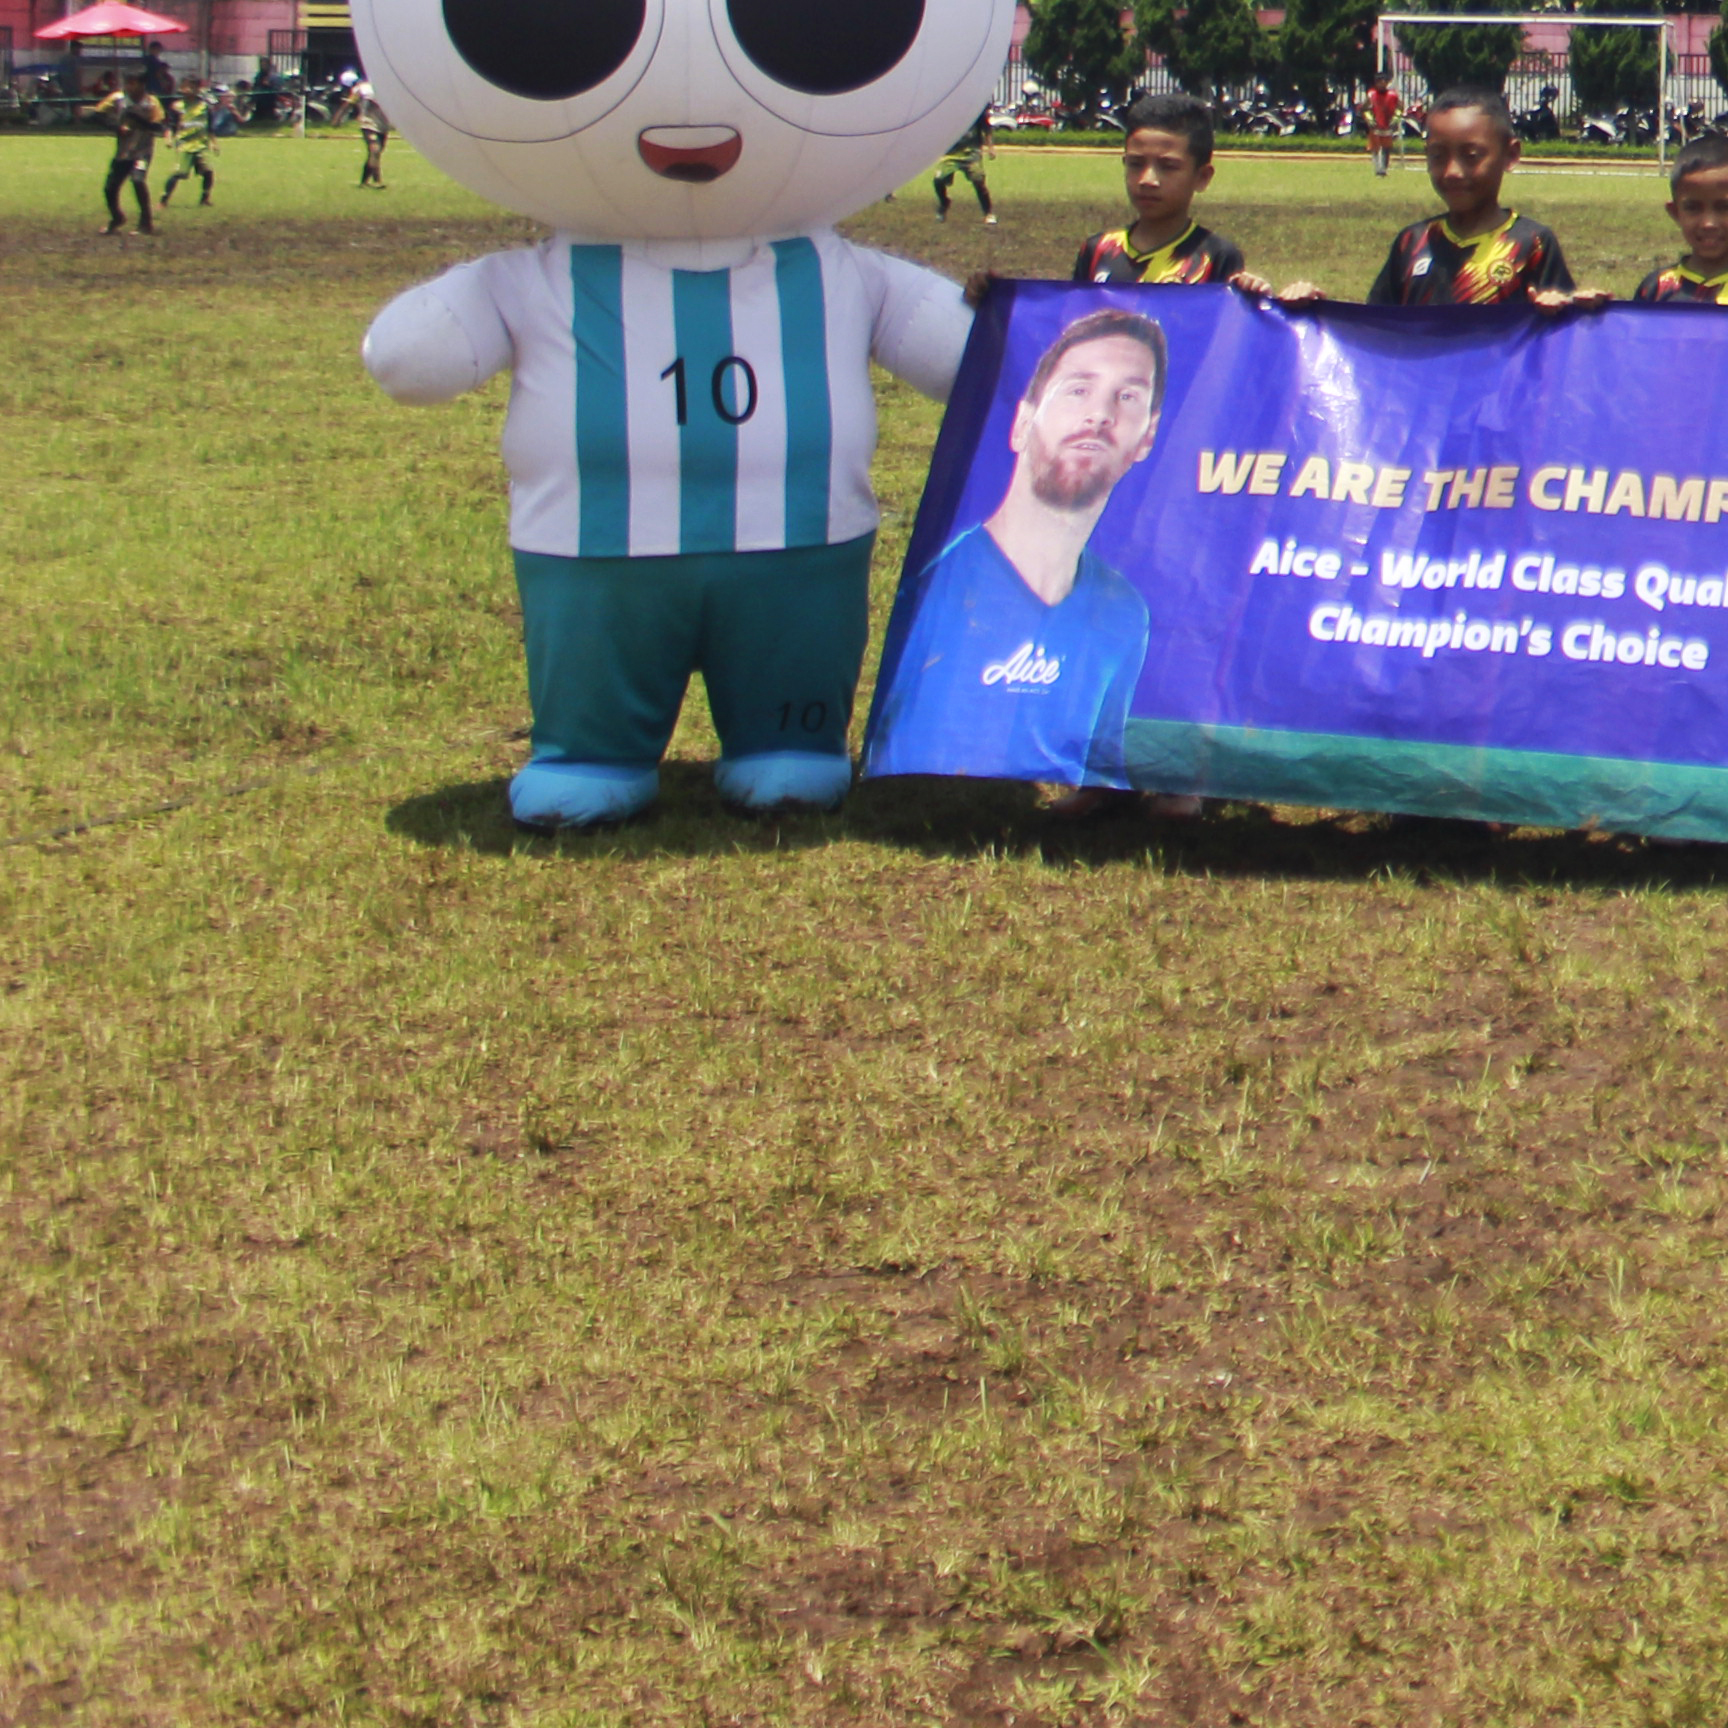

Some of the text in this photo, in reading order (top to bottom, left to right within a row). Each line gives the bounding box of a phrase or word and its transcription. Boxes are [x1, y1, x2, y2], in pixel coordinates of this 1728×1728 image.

[660, 355, 758, 426] 10
[1198, 451, 1287, 495] WE
[1290, 456, 1411, 508] ARE
[1423, 466, 1520, 511] THE
[1249, 538, 1342, 580] Aice
[1380, 551, 1508, 590] World
[1511, 555, 1626, 600] Class
[982, 642, 1061, 685] Aice
[1309, 605, 1710, 671] Champion's Choice
[775, 700, 829, 734] 10
